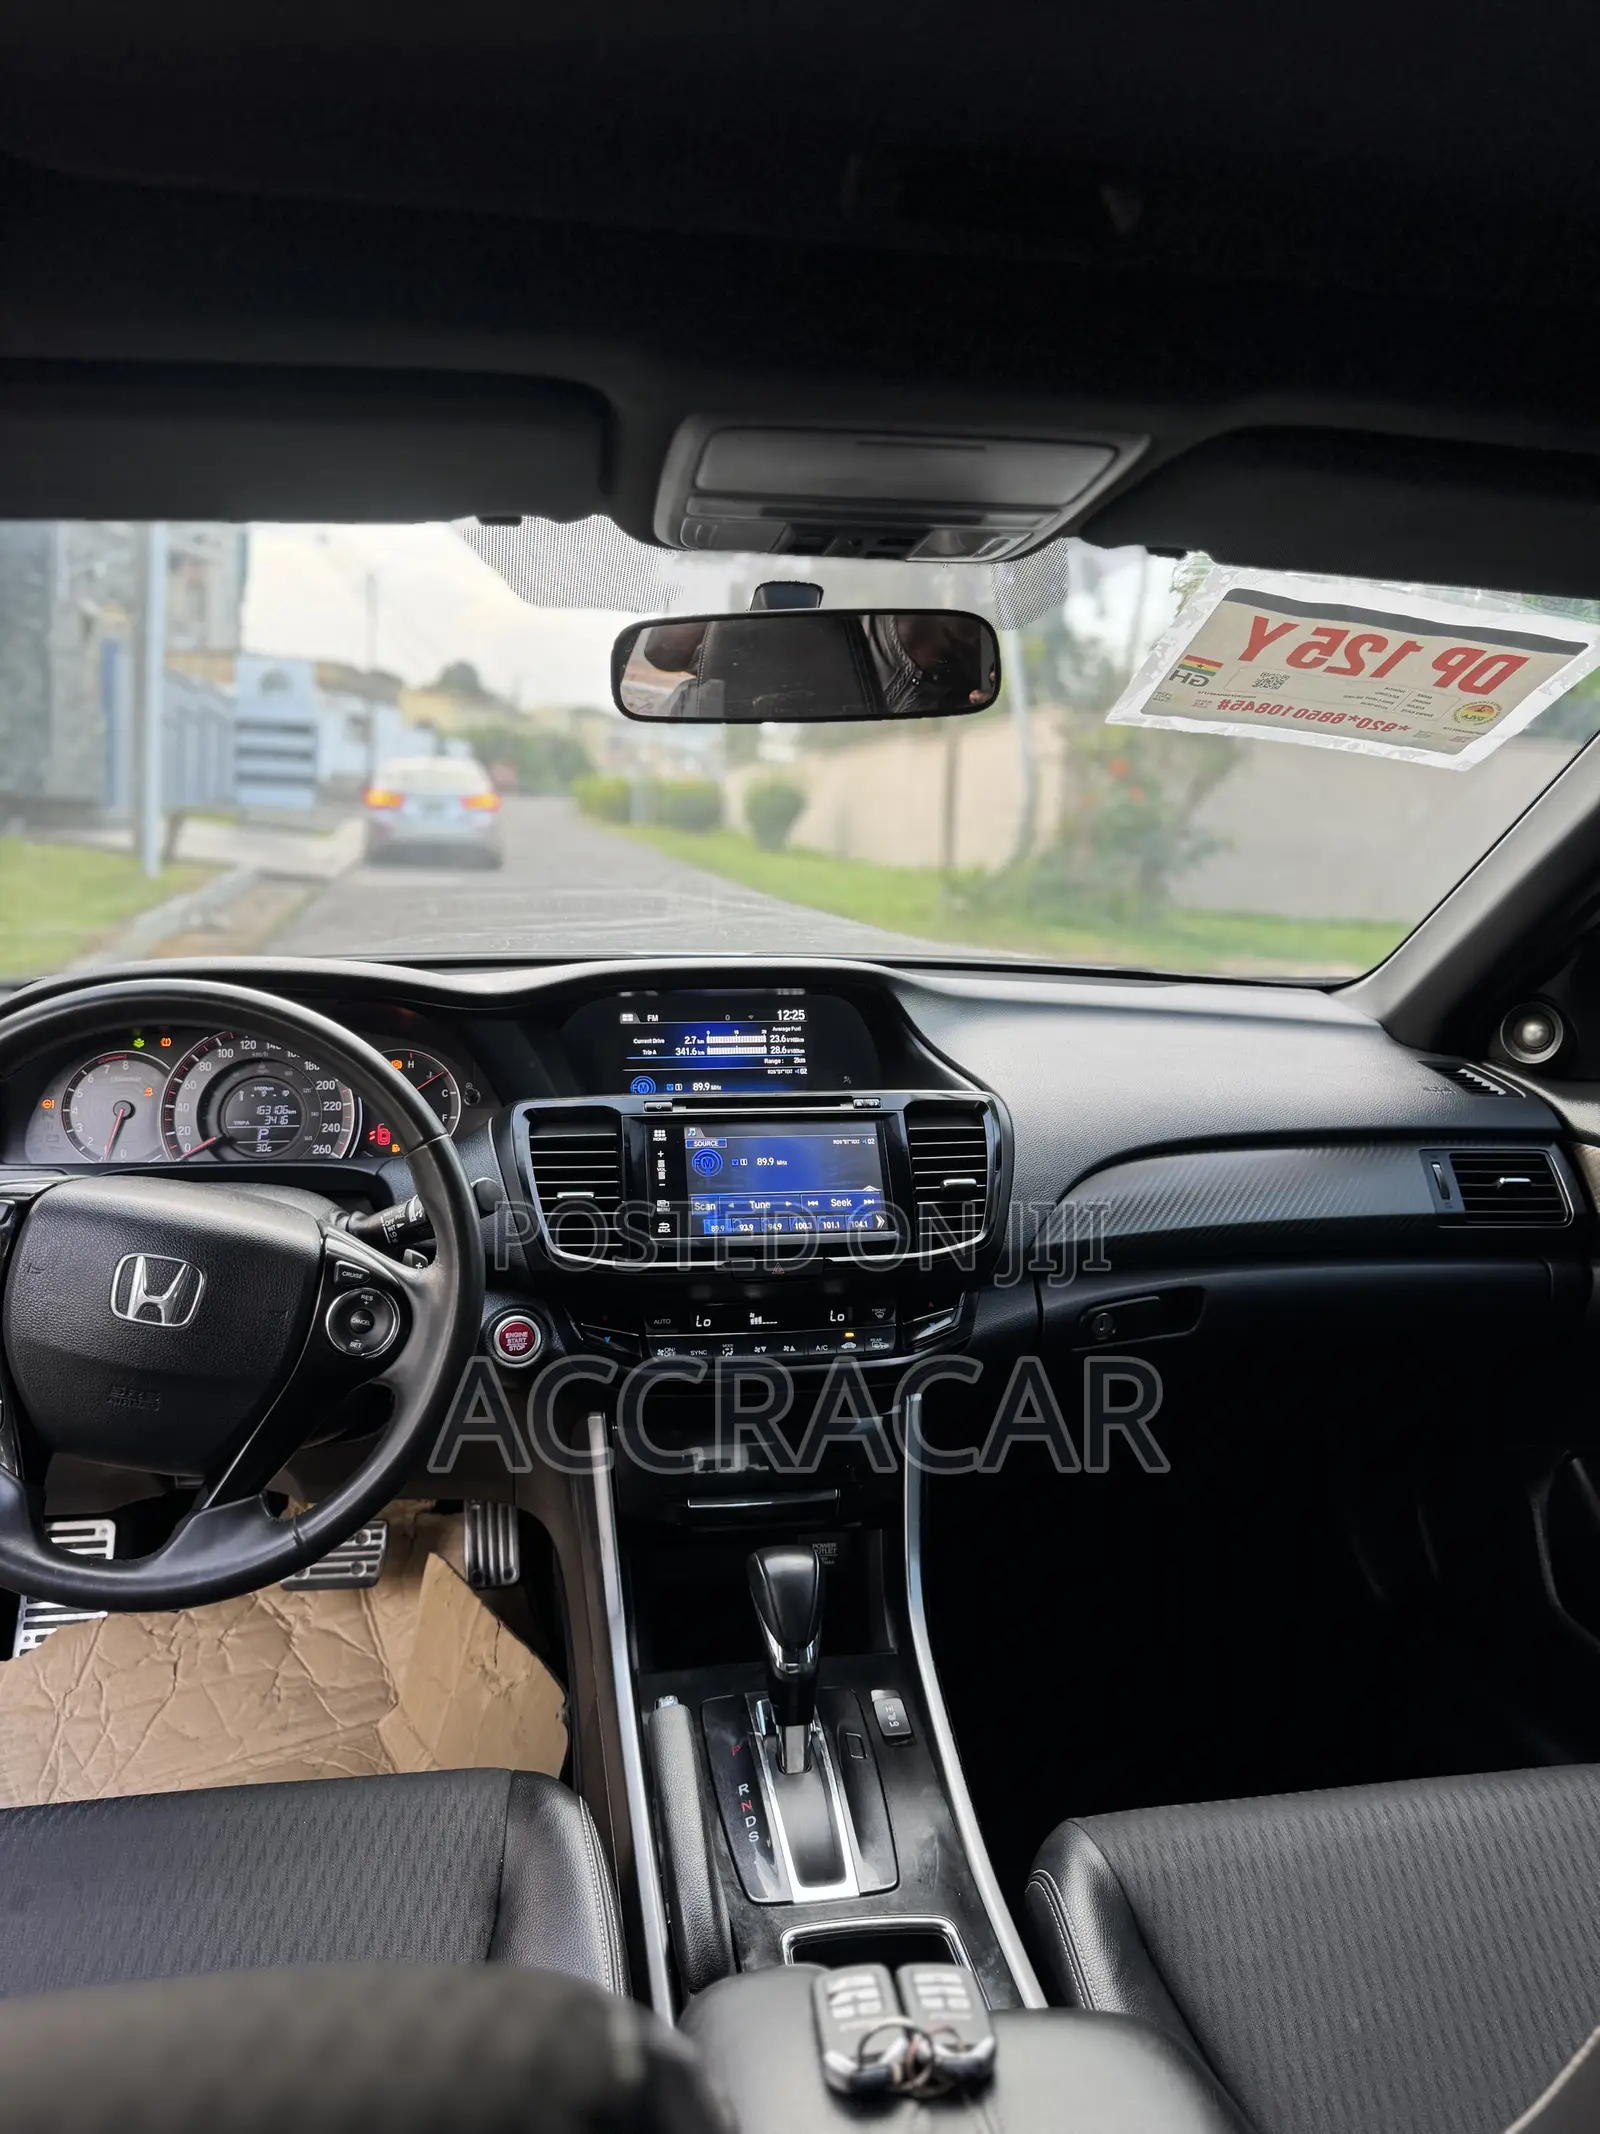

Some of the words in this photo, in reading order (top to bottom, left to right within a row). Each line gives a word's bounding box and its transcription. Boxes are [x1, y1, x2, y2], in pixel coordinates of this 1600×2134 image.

[777, 1009, 805, 1020] 12:25
[684, 1036, 697, 1044] 2.7
[770, 1035, 787, 1043] 23.6
[240, 1040, 257, 1050] 120
[217, 1048, 235, 1058] 100
[675, 1047, 697, 1056] 341.6
[770, 1046, 787, 1054] 28.6
[122, 1061, 129, 1070] 8
[199, 1062, 212, 1071] 80
[407, 1060, 415, 1069] H
[104, 1065, 111, 1074] 7
[87, 1075, 94, 1083] 6
[184, 1080, 197, 1090] 60
[316, 1080, 336, 1090] 200
[692, 1082, 711, 1091] 89.9
[75, 1089, 83, 1098] 5
[441, 1089, 449, 1097] C
[176, 1103, 190, 1112] 40
[323, 1101, 342, 1111] 220
[72, 1107, 79, 1115] 4
[442, 1113, 448, 1122] F
[76, 1123, 83, 1132] 3
[179, 1126, 191, 1135] 20
[322, 1123, 341, 1133] 240
[257, 1128, 270, 1140] P
[87, 1137, 94, 1146] 2
[184, 1142, 192, 1153] 0
[312, 1144, 332, 1155] 260
[120, 1149, 127, 1158] 0
[756, 1158, 775, 1166] 89.9
[694, 1202, 716, 1211] Scan
[749, 1200, 771, 1209] Tune
[830, 1198, 852, 1207] Seek
[739, 1223, 754, 1231] 93.9
[795, 1222, 813, 1230] 100.3
[823, 1221, 840, 1229] 101.1
[850, 1220, 868, 1228] 104.1
[341, 1270, 364, 1279] CRUISE
[816, 1344, 828, 1352] A/C
[690, 1349, 708, 1357] SYNC
[731, 1745, 741, 1756] P
[738, 1783, 750, 1796] R
[741, 1800, 753, 1813] N
[745, 1815, 757, 1828] D
[748, 1831, 760, 1842] S
